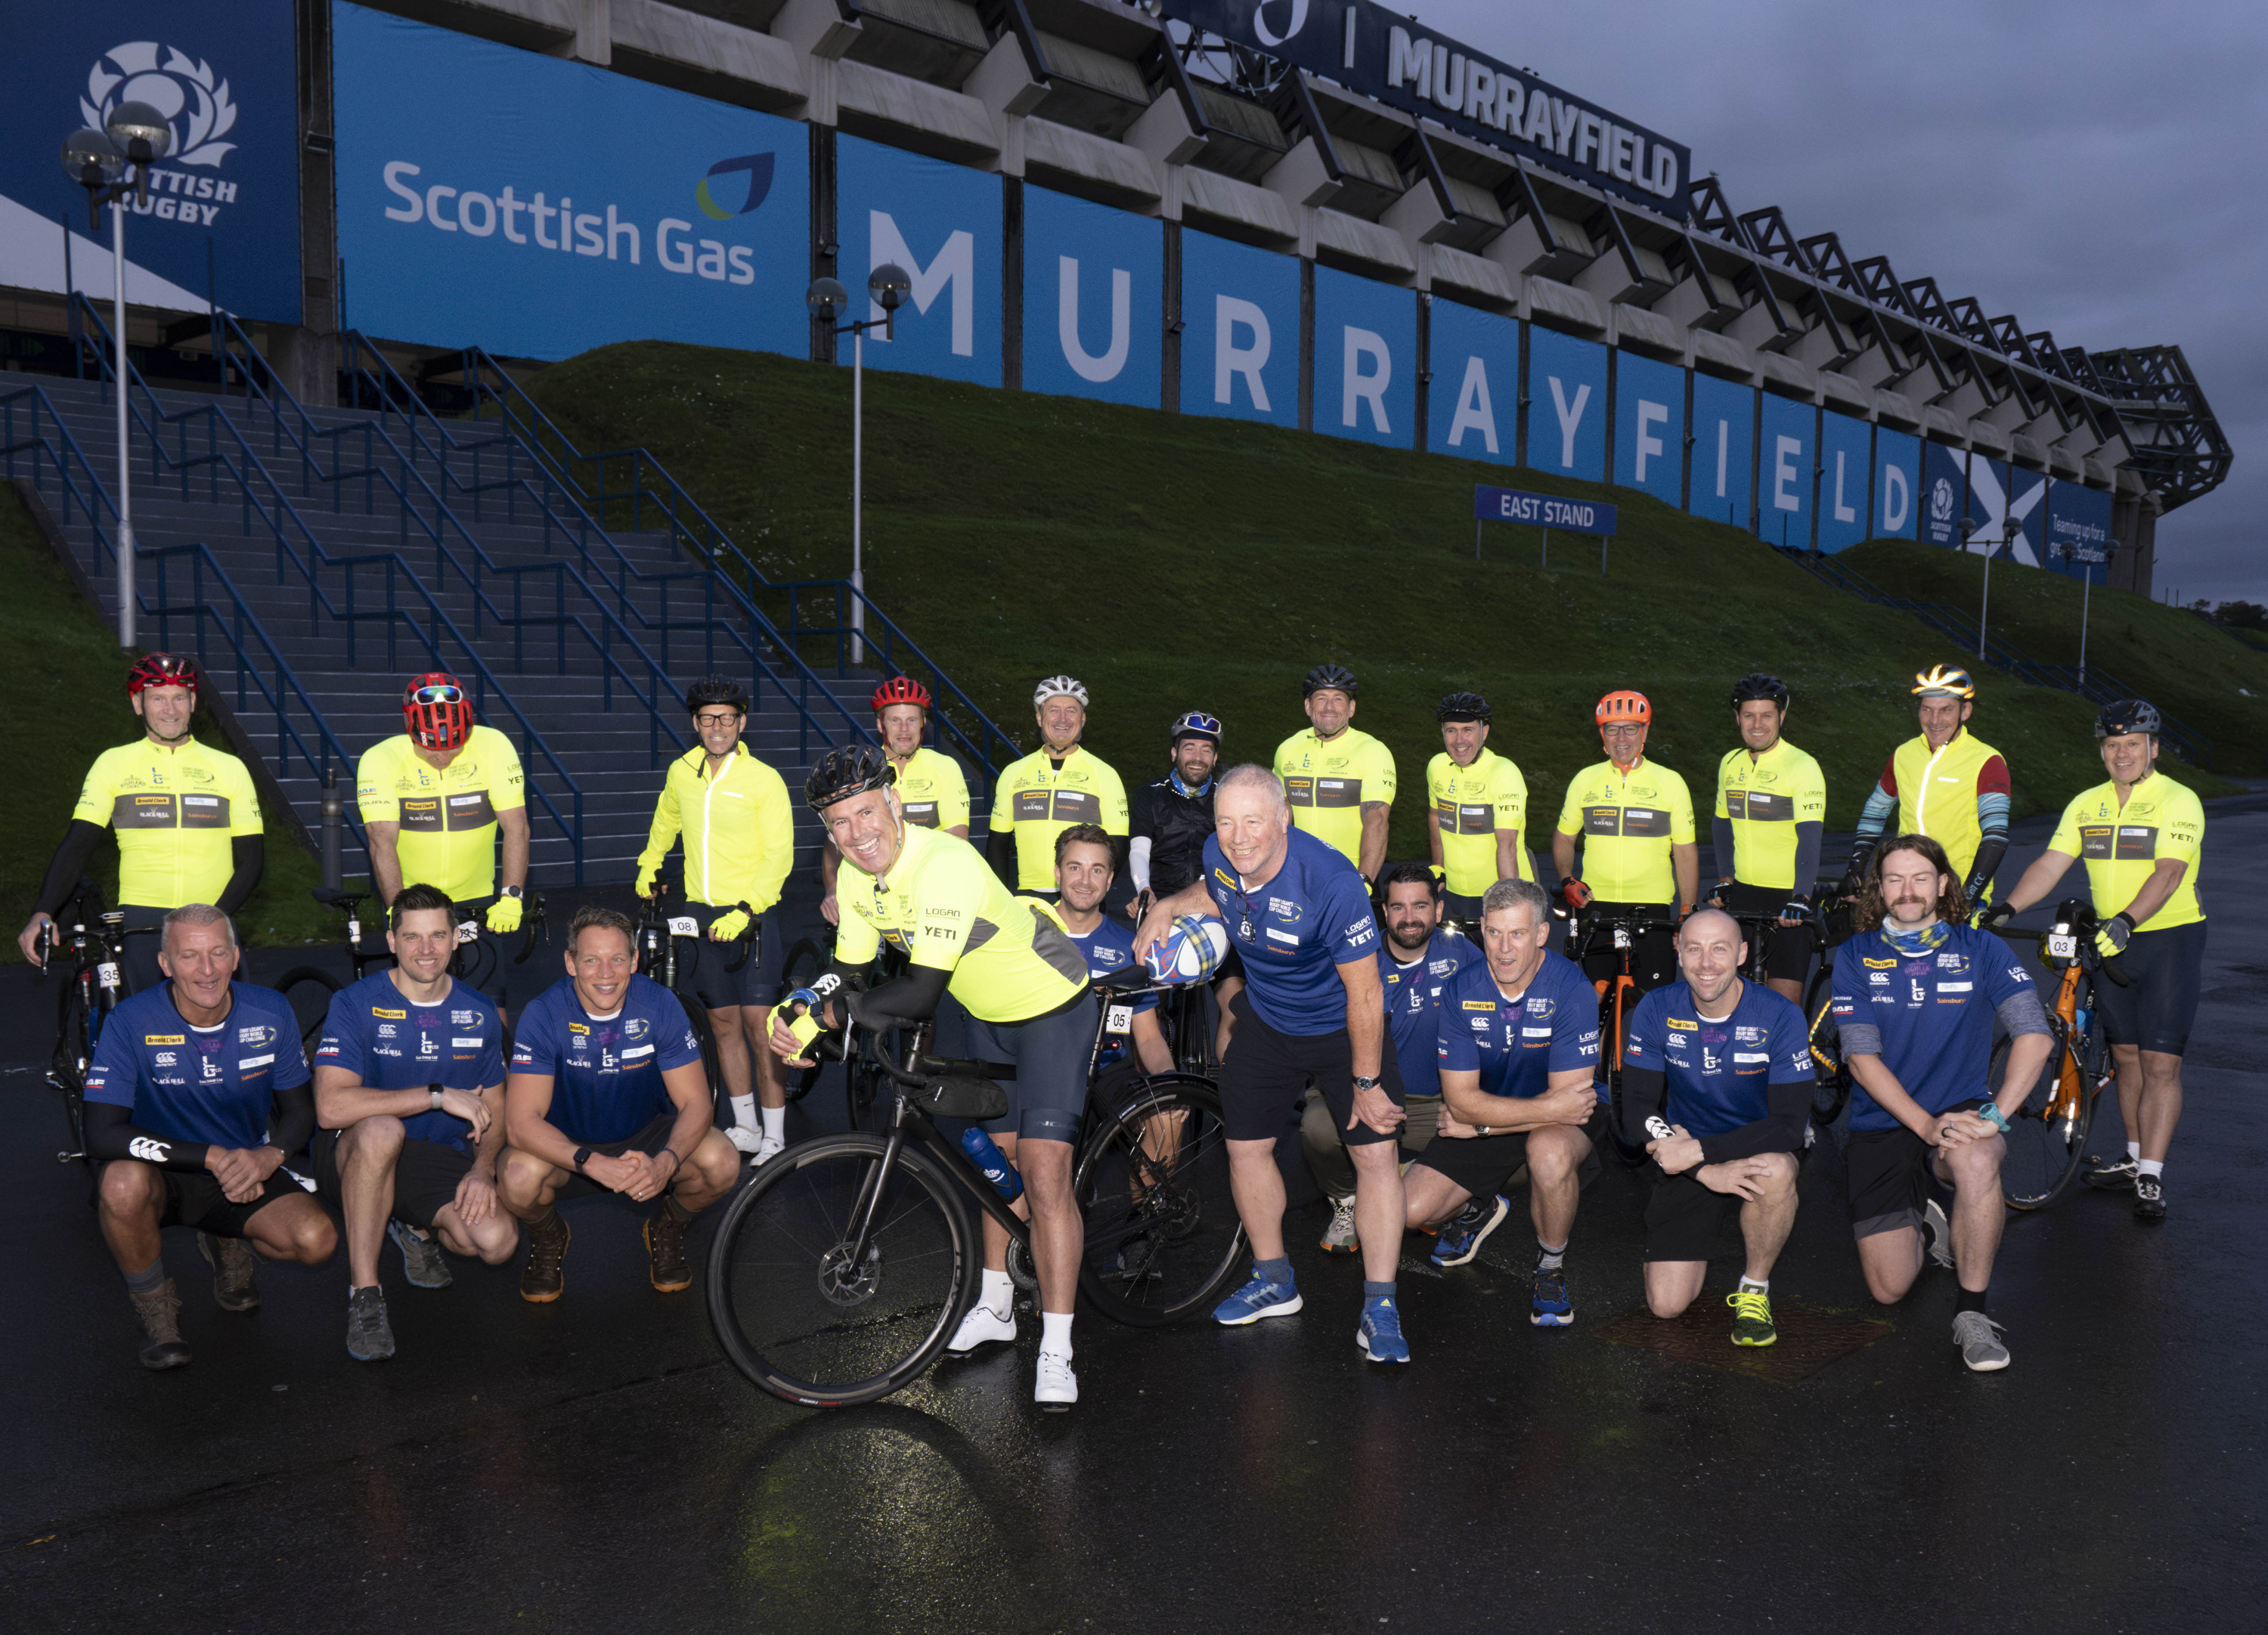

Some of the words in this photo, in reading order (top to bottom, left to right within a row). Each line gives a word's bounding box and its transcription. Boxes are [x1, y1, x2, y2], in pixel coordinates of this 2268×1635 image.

[1388, 26, 1678, 198] MURRAYFIELD
[383, 161, 640, 264] Scottish
[657, 218, 754, 285] Gas
[1501, 494, 1541, 520] EAST
[1544, 501, 1594, 527] STAND
[1930, 522, 1952, 533] SCOTTISH
[2053, 514, 2081, 540] Teaming
[2082, 525, 2090, 542] up
[2091, 523, 2100, 540] for
[2100, 530, 2105, 541] a
[1932, 532, 1949, 542] RUGBY
[2172, 821, 2198, 830] LOGAN
[2170, 832, 2194, 843] YETI
[925, 908, 960, 918] LOGAN
[1275, 908, 1292, 916] CHALLENGE
[677, 921, 692, 931] 08
[1346, 915, 1370, 934] LOGAN
[925, 926, 956, 940] YETI
[1347, 928, 1374, 946] YETI
[1267, 945, 1295, 955] Sainsbury's
[2054, 942, 2068, 952] 03
[104, 970, 119, 981] 35
[374, 1008, 389, 1017] Arnold
[1114, 1014, 1125, 1027] 05
[373, 1047, 389, 1055] BLACK
[622, 1060, 651, 1070] Sainsbury's
[240, 1069, 268, 1081] Sainsbury's
